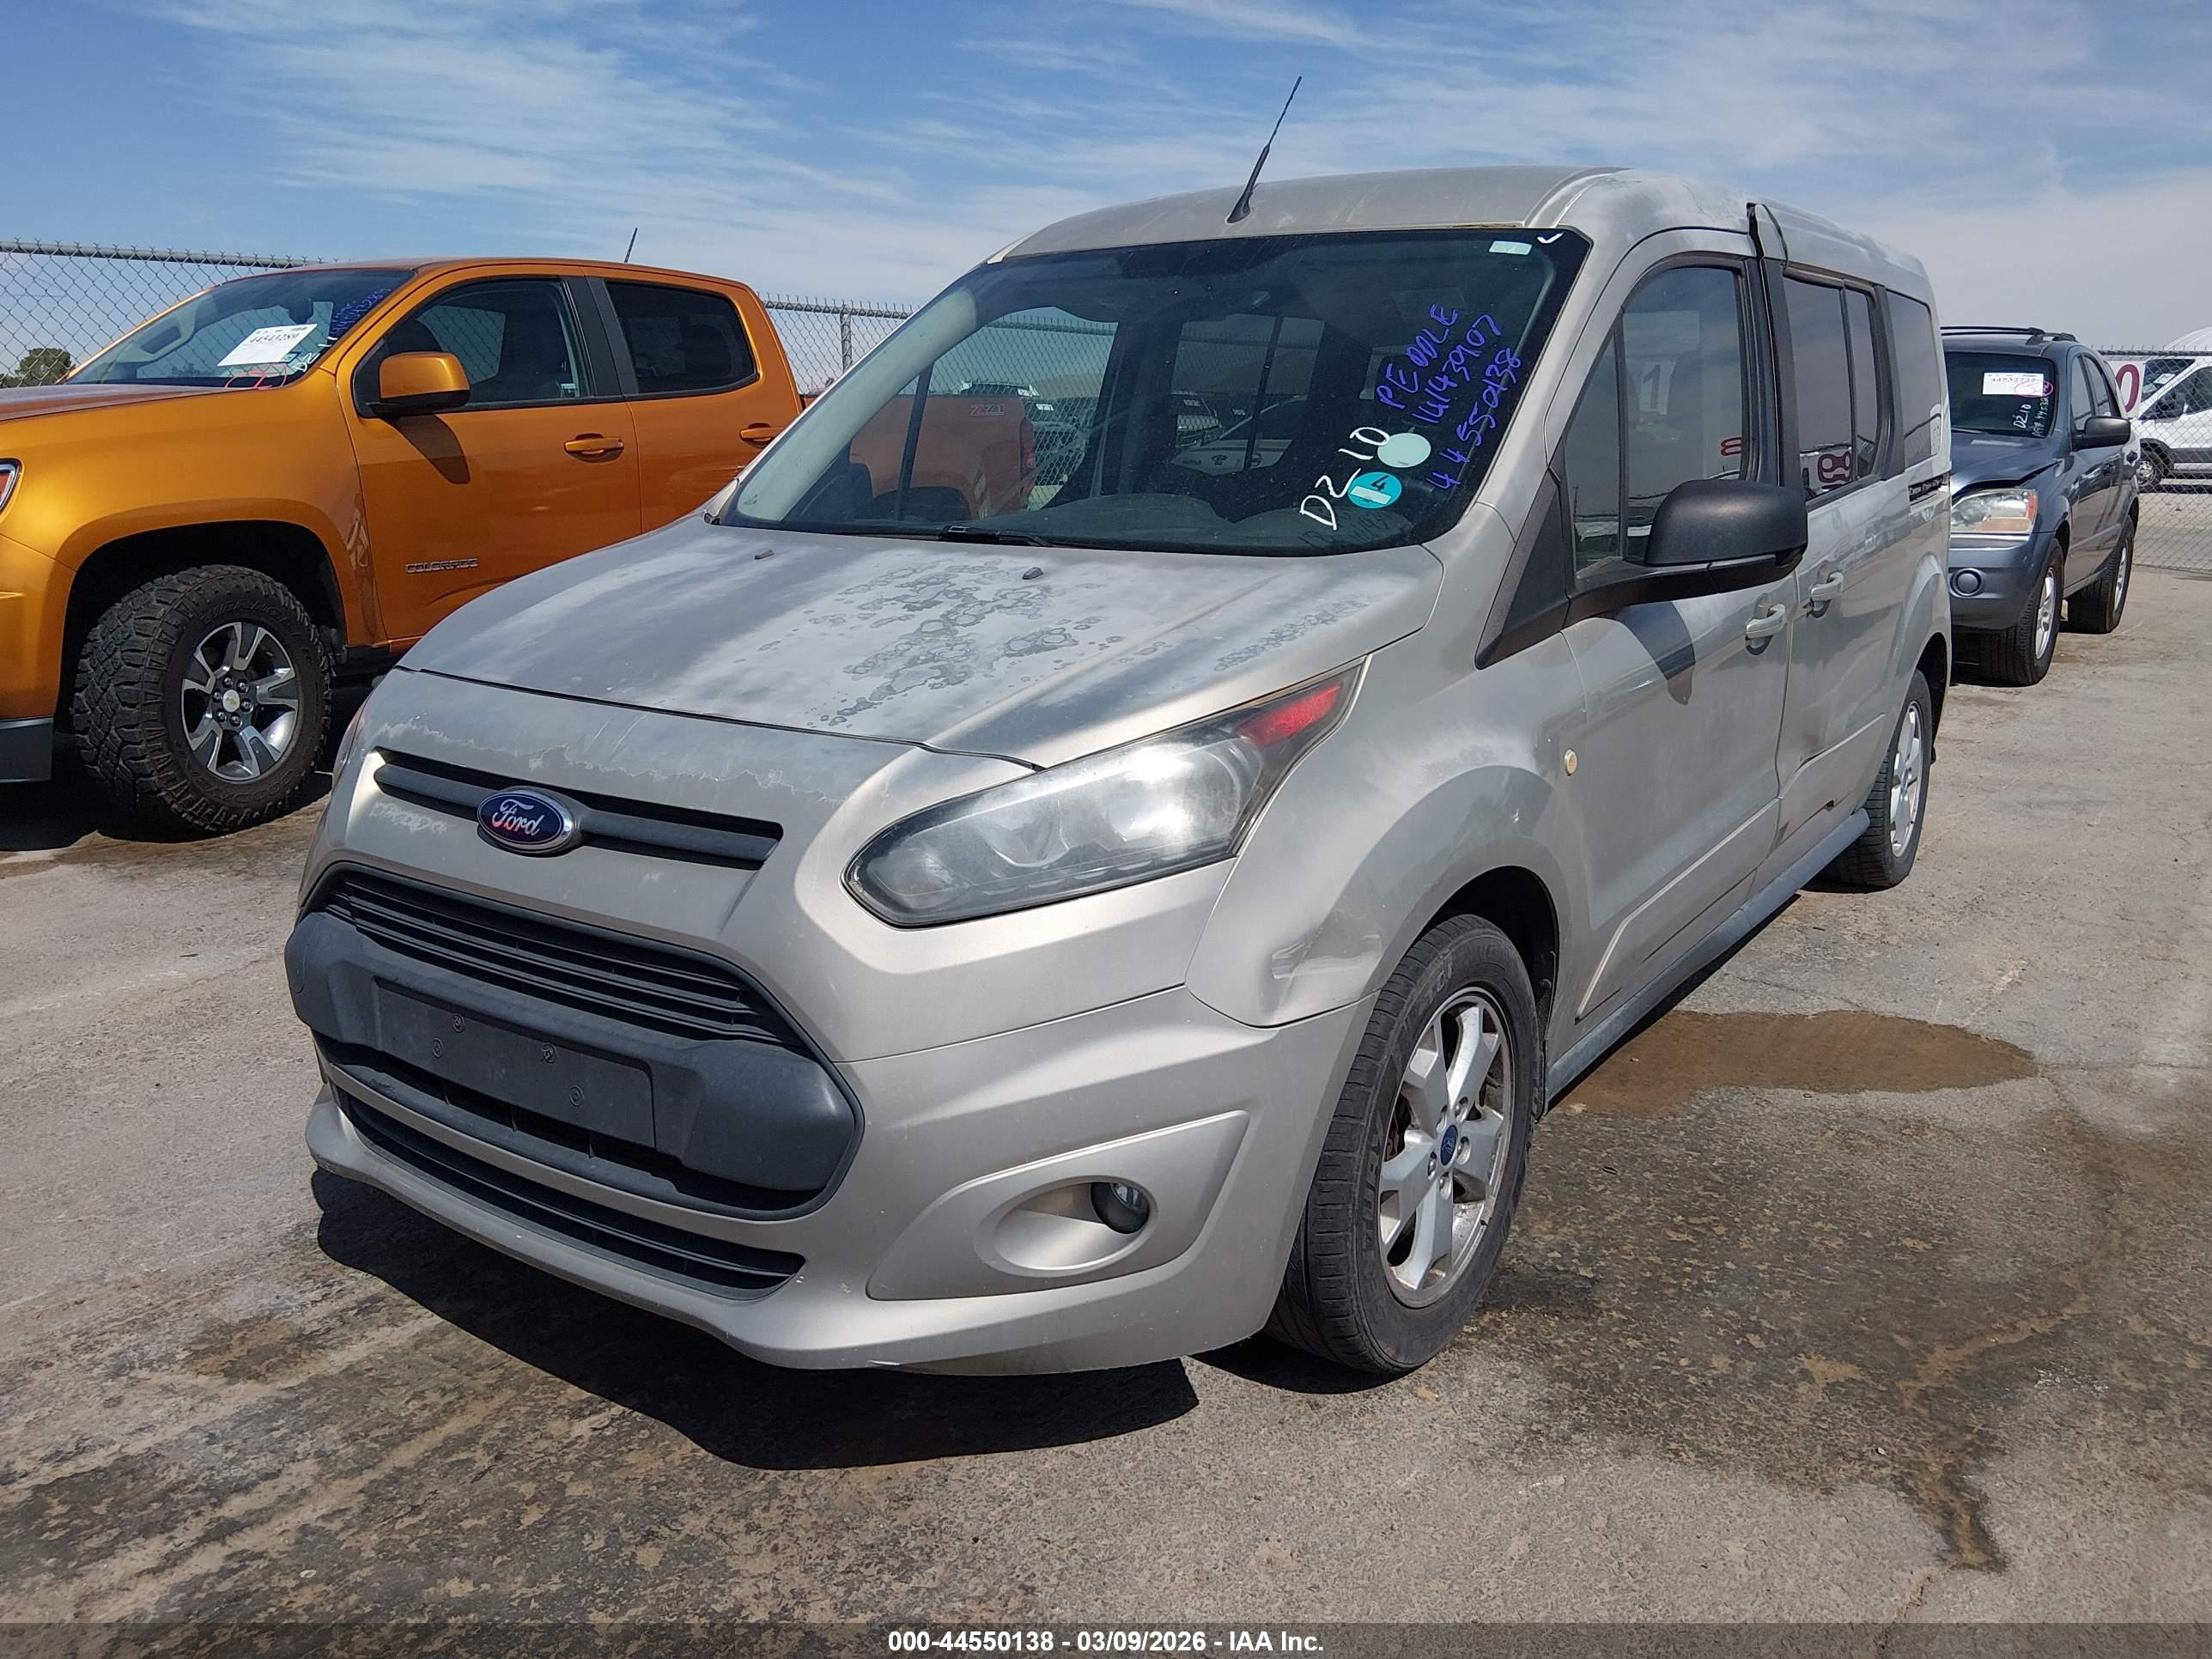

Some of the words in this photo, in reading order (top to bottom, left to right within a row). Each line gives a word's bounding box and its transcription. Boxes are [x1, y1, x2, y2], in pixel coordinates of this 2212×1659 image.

[1426, 347, 1522, 489] 44550138
[405, 558, 478, 574] COLORADO
[491, 799, 545, 836] Ford
